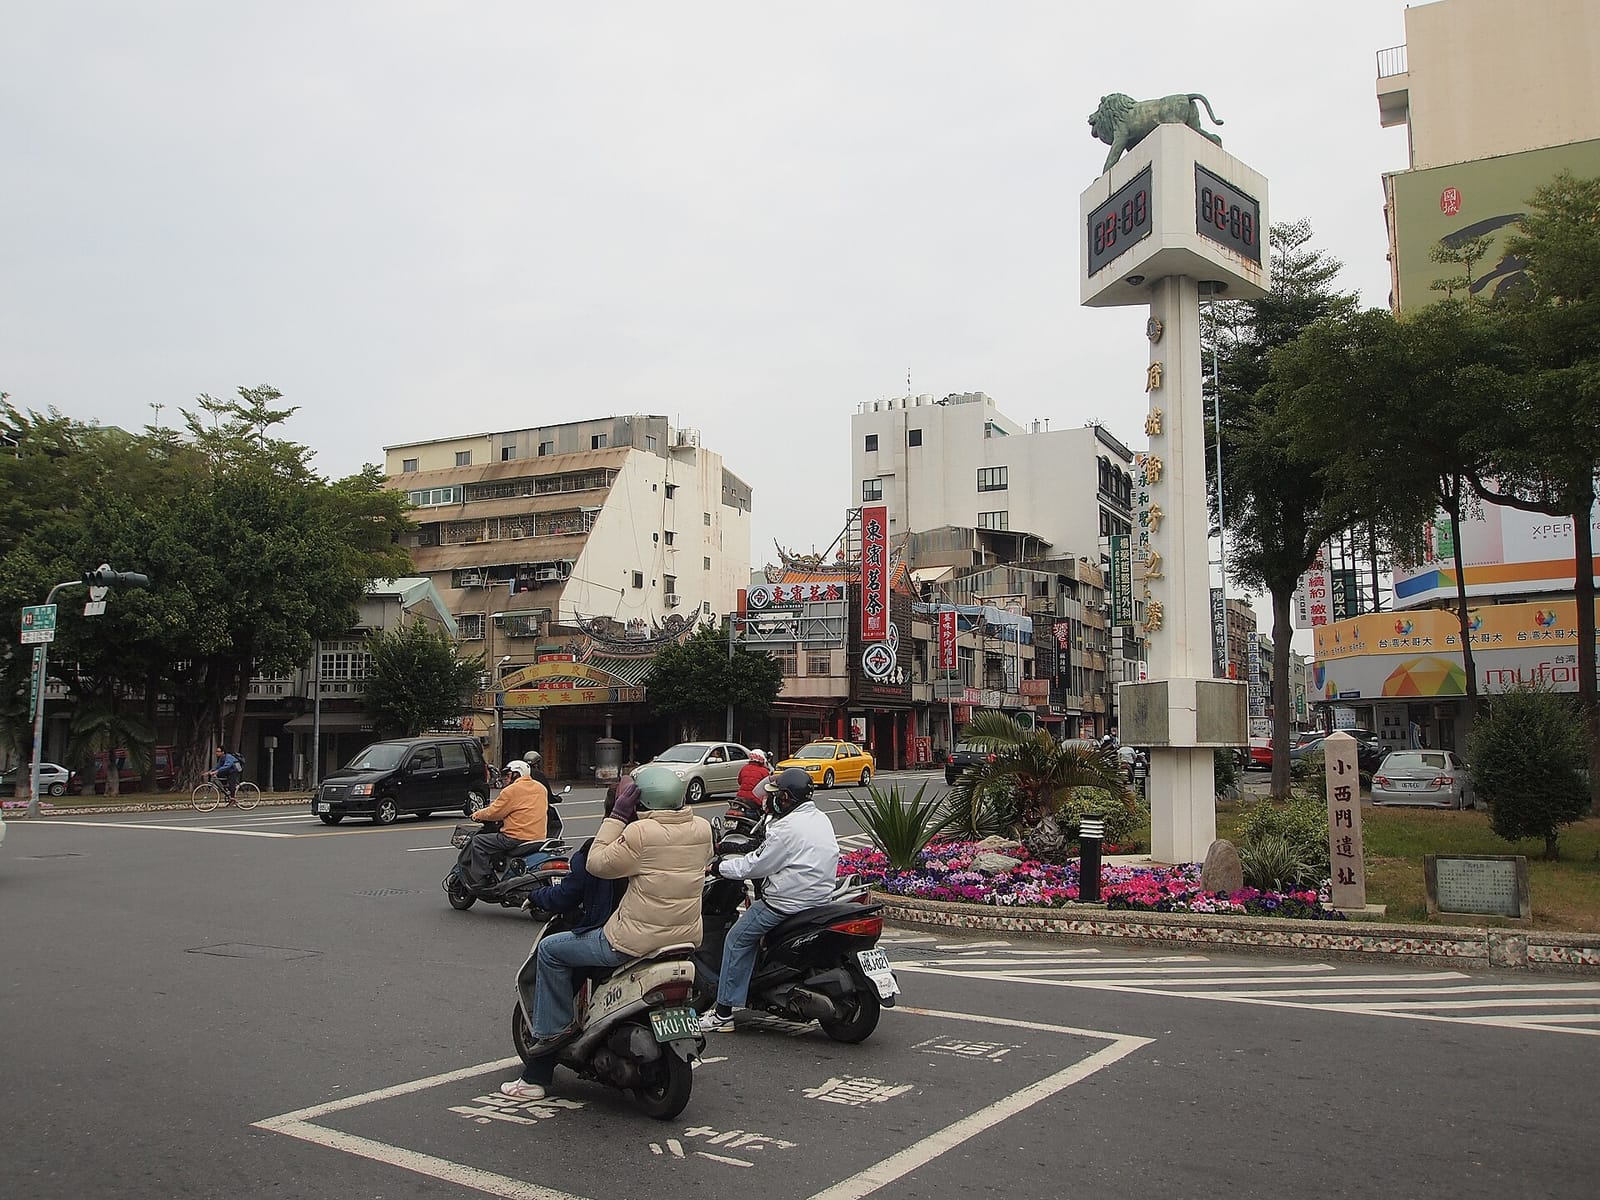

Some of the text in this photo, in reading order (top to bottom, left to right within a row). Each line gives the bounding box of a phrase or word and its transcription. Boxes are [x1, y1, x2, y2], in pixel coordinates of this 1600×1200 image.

[1532, 523, 1573, 536] XPER
[771, 583, 840, 605] 東賓茗茶
[864, 518, 884, 617] 東賓茗茶
[1332, 759, 1357, 887] 小西門遺址
